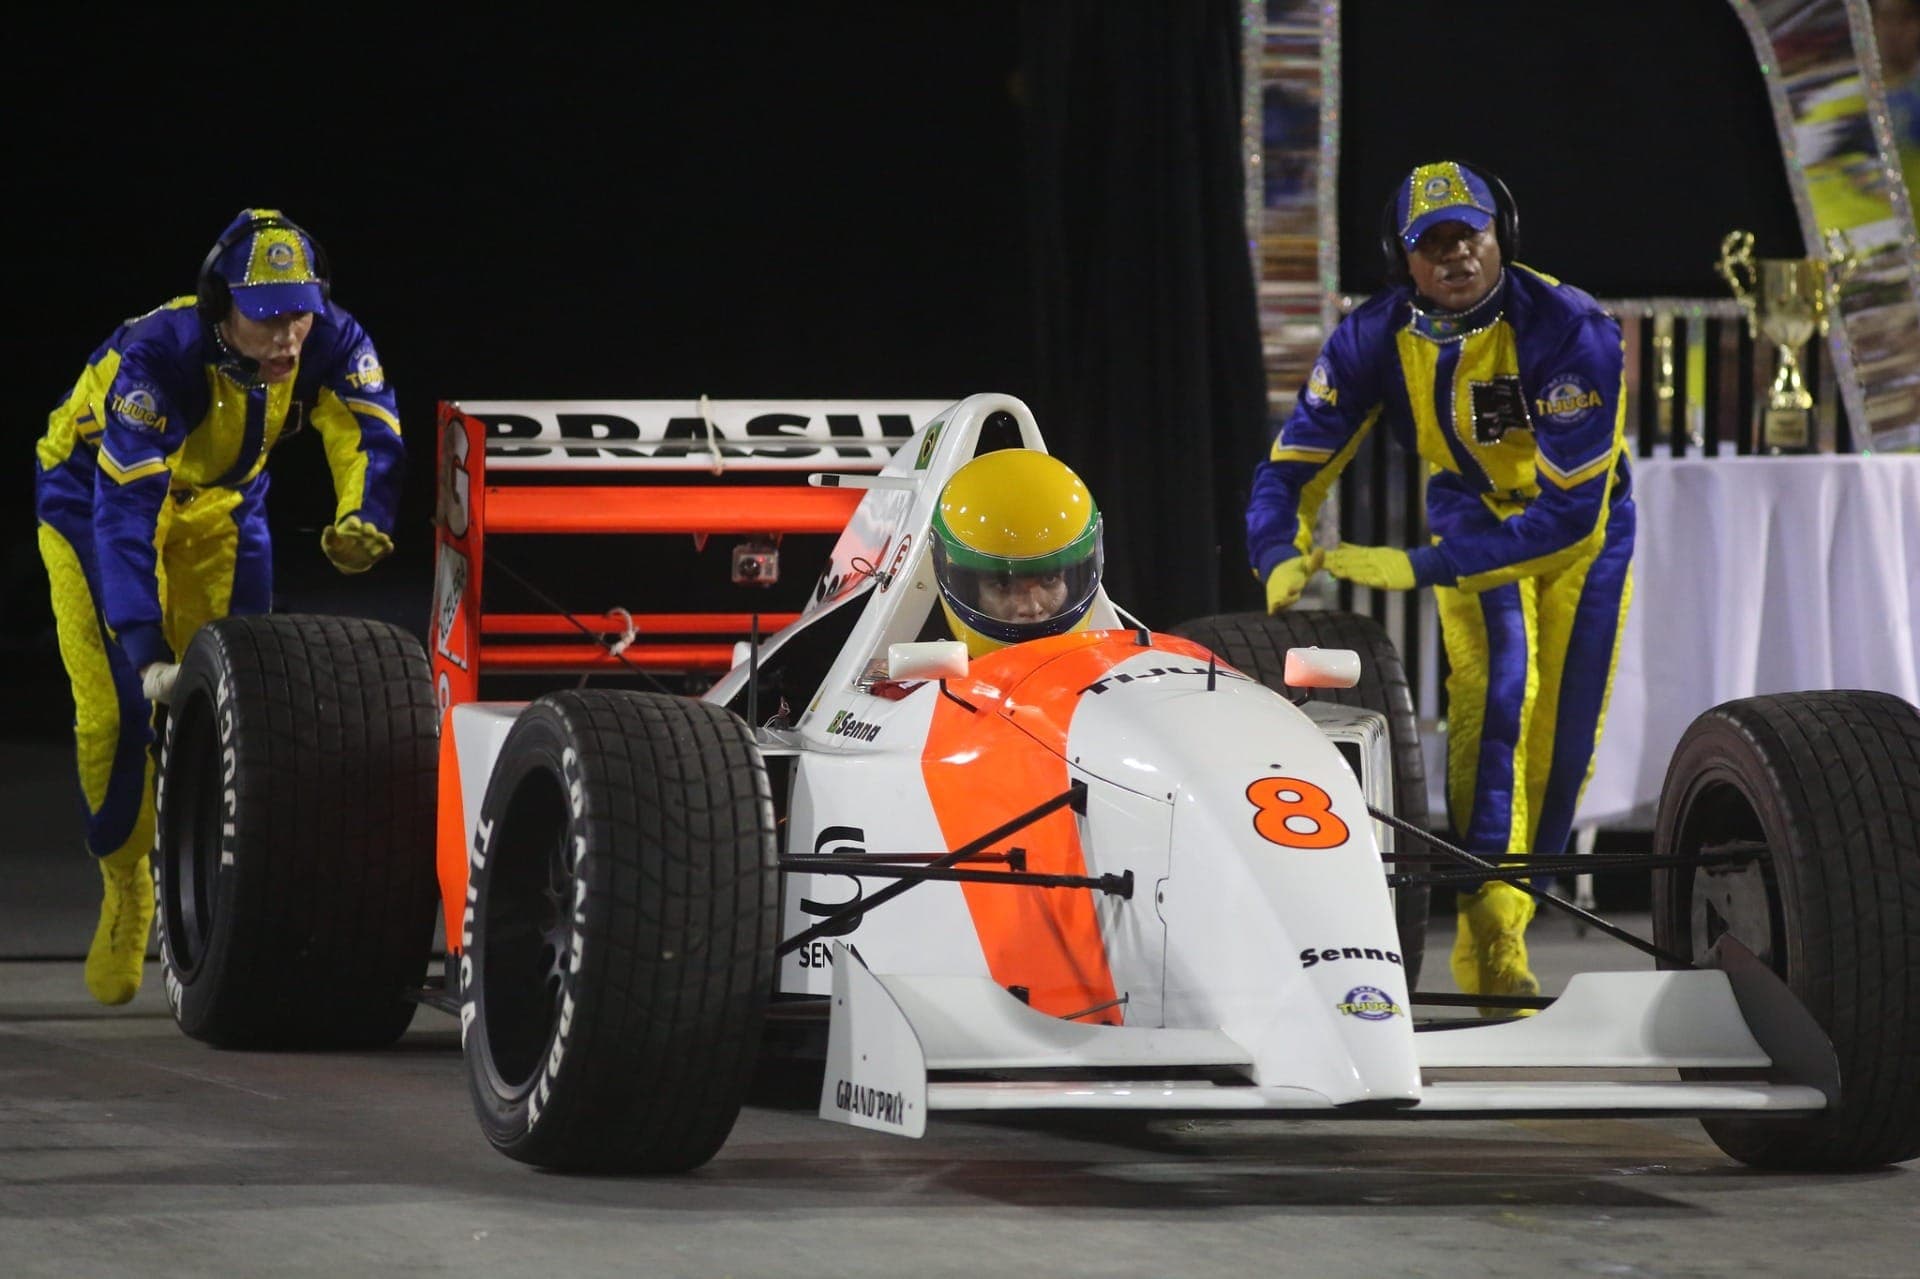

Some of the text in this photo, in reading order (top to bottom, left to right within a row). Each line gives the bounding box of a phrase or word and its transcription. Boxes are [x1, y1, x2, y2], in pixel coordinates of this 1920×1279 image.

[111, 393, 167, 434] TIJUCA
[1535, 390, 1603, 416] TIJUCA
[1077, 667, 1262, 696] TIJUC
[835, 712, 881, 742] Senna
[1245, 776, 1350, 849] 8
[1299, 947, 1402, 968] Senna
[1336, 1002, 1404, 1017] TIJUCA
[837, 1079, 904, 1125] GRAND PRIX
